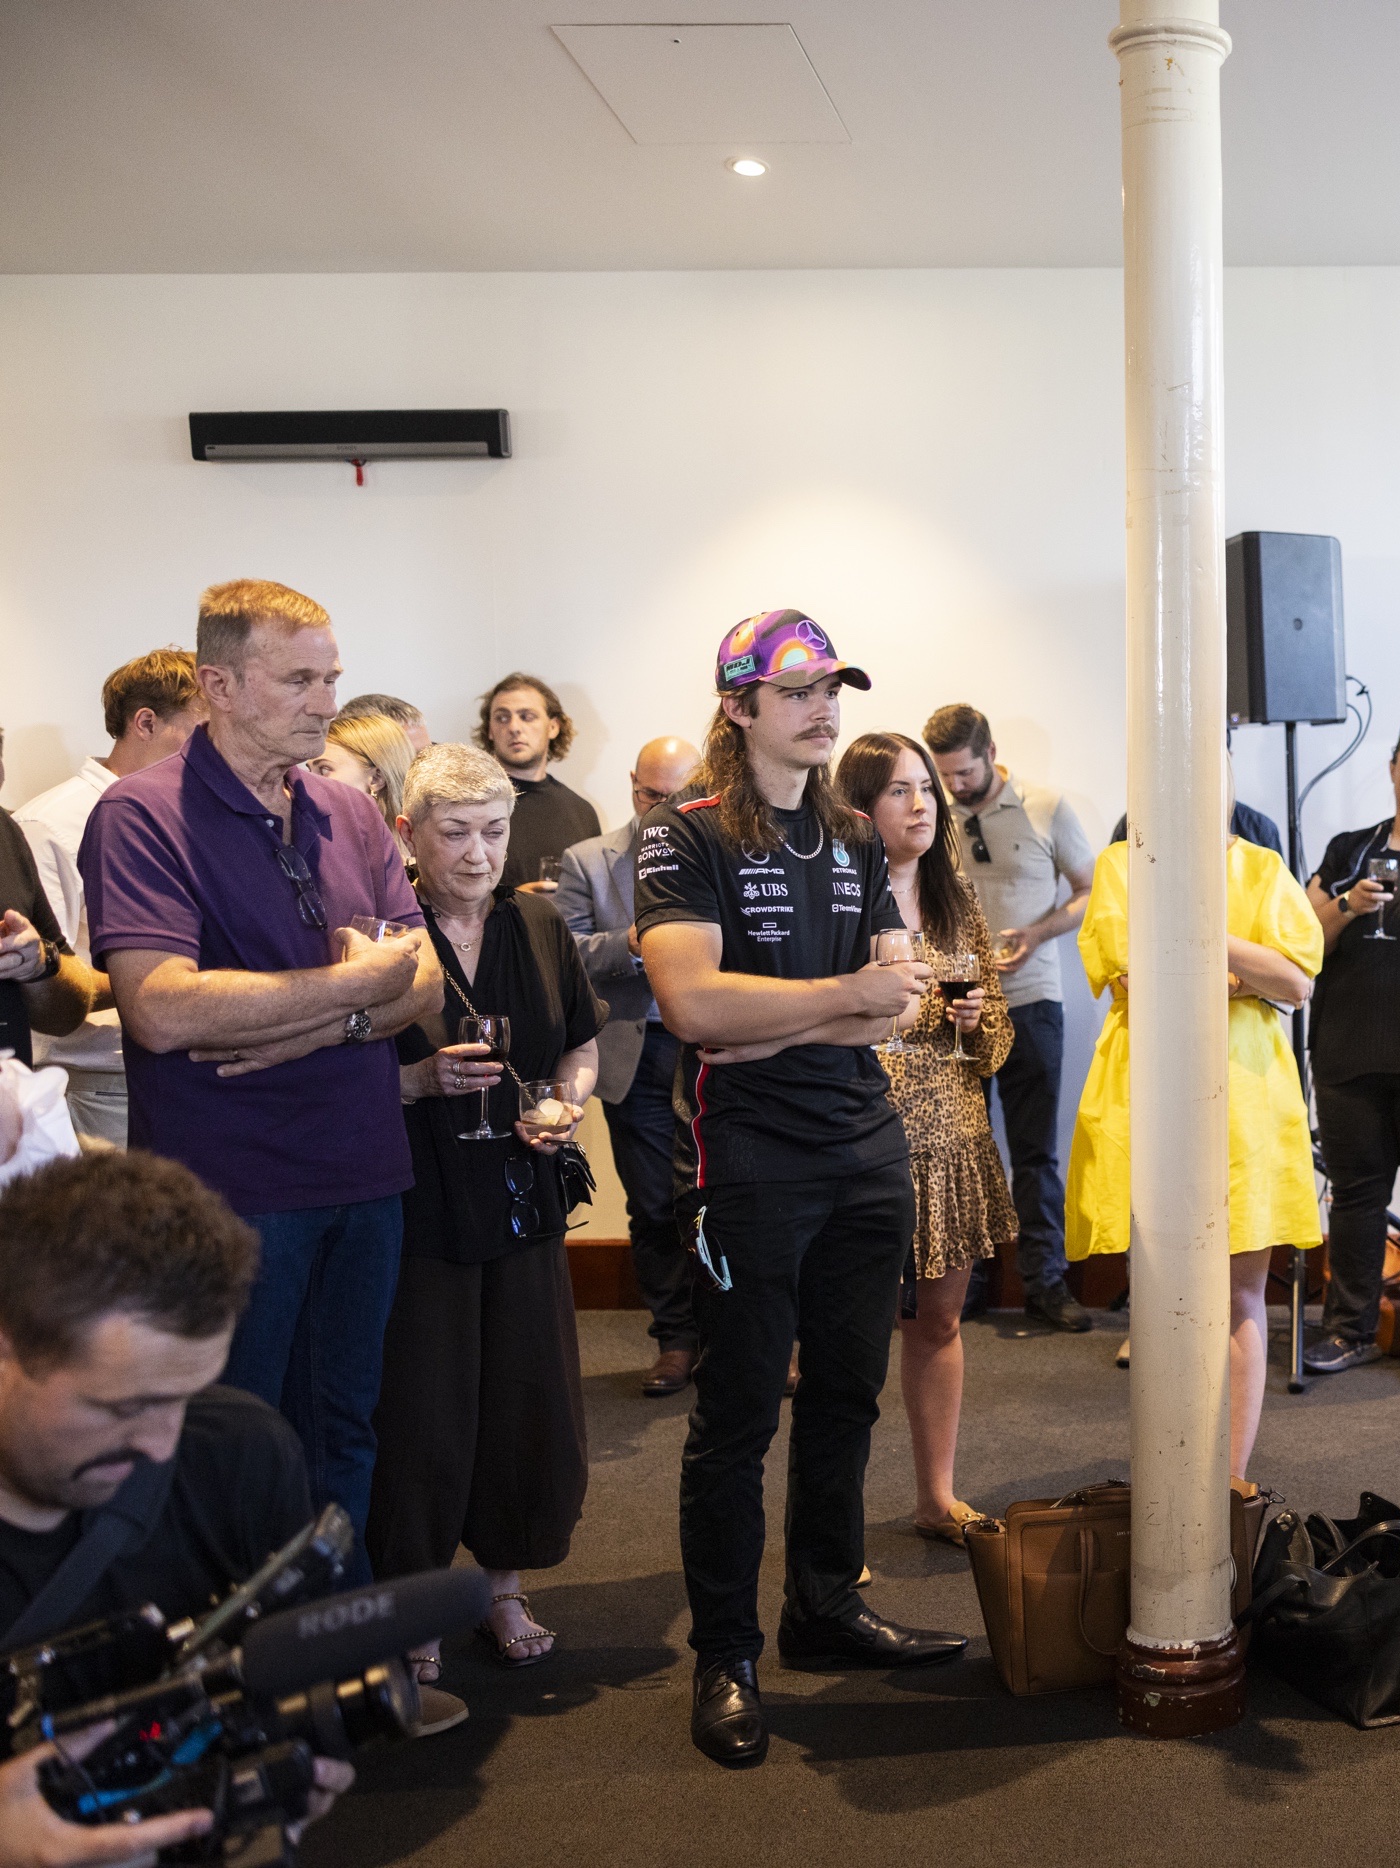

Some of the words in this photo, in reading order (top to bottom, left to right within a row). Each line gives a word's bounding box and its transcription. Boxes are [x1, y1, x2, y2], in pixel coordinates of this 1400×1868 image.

[643, 826, 670, 840] IWC
[638, 848, 675, 863] BONVOY
[760, 883, 789, 897] UBS
[832, 882, 861, 897] INEOS
